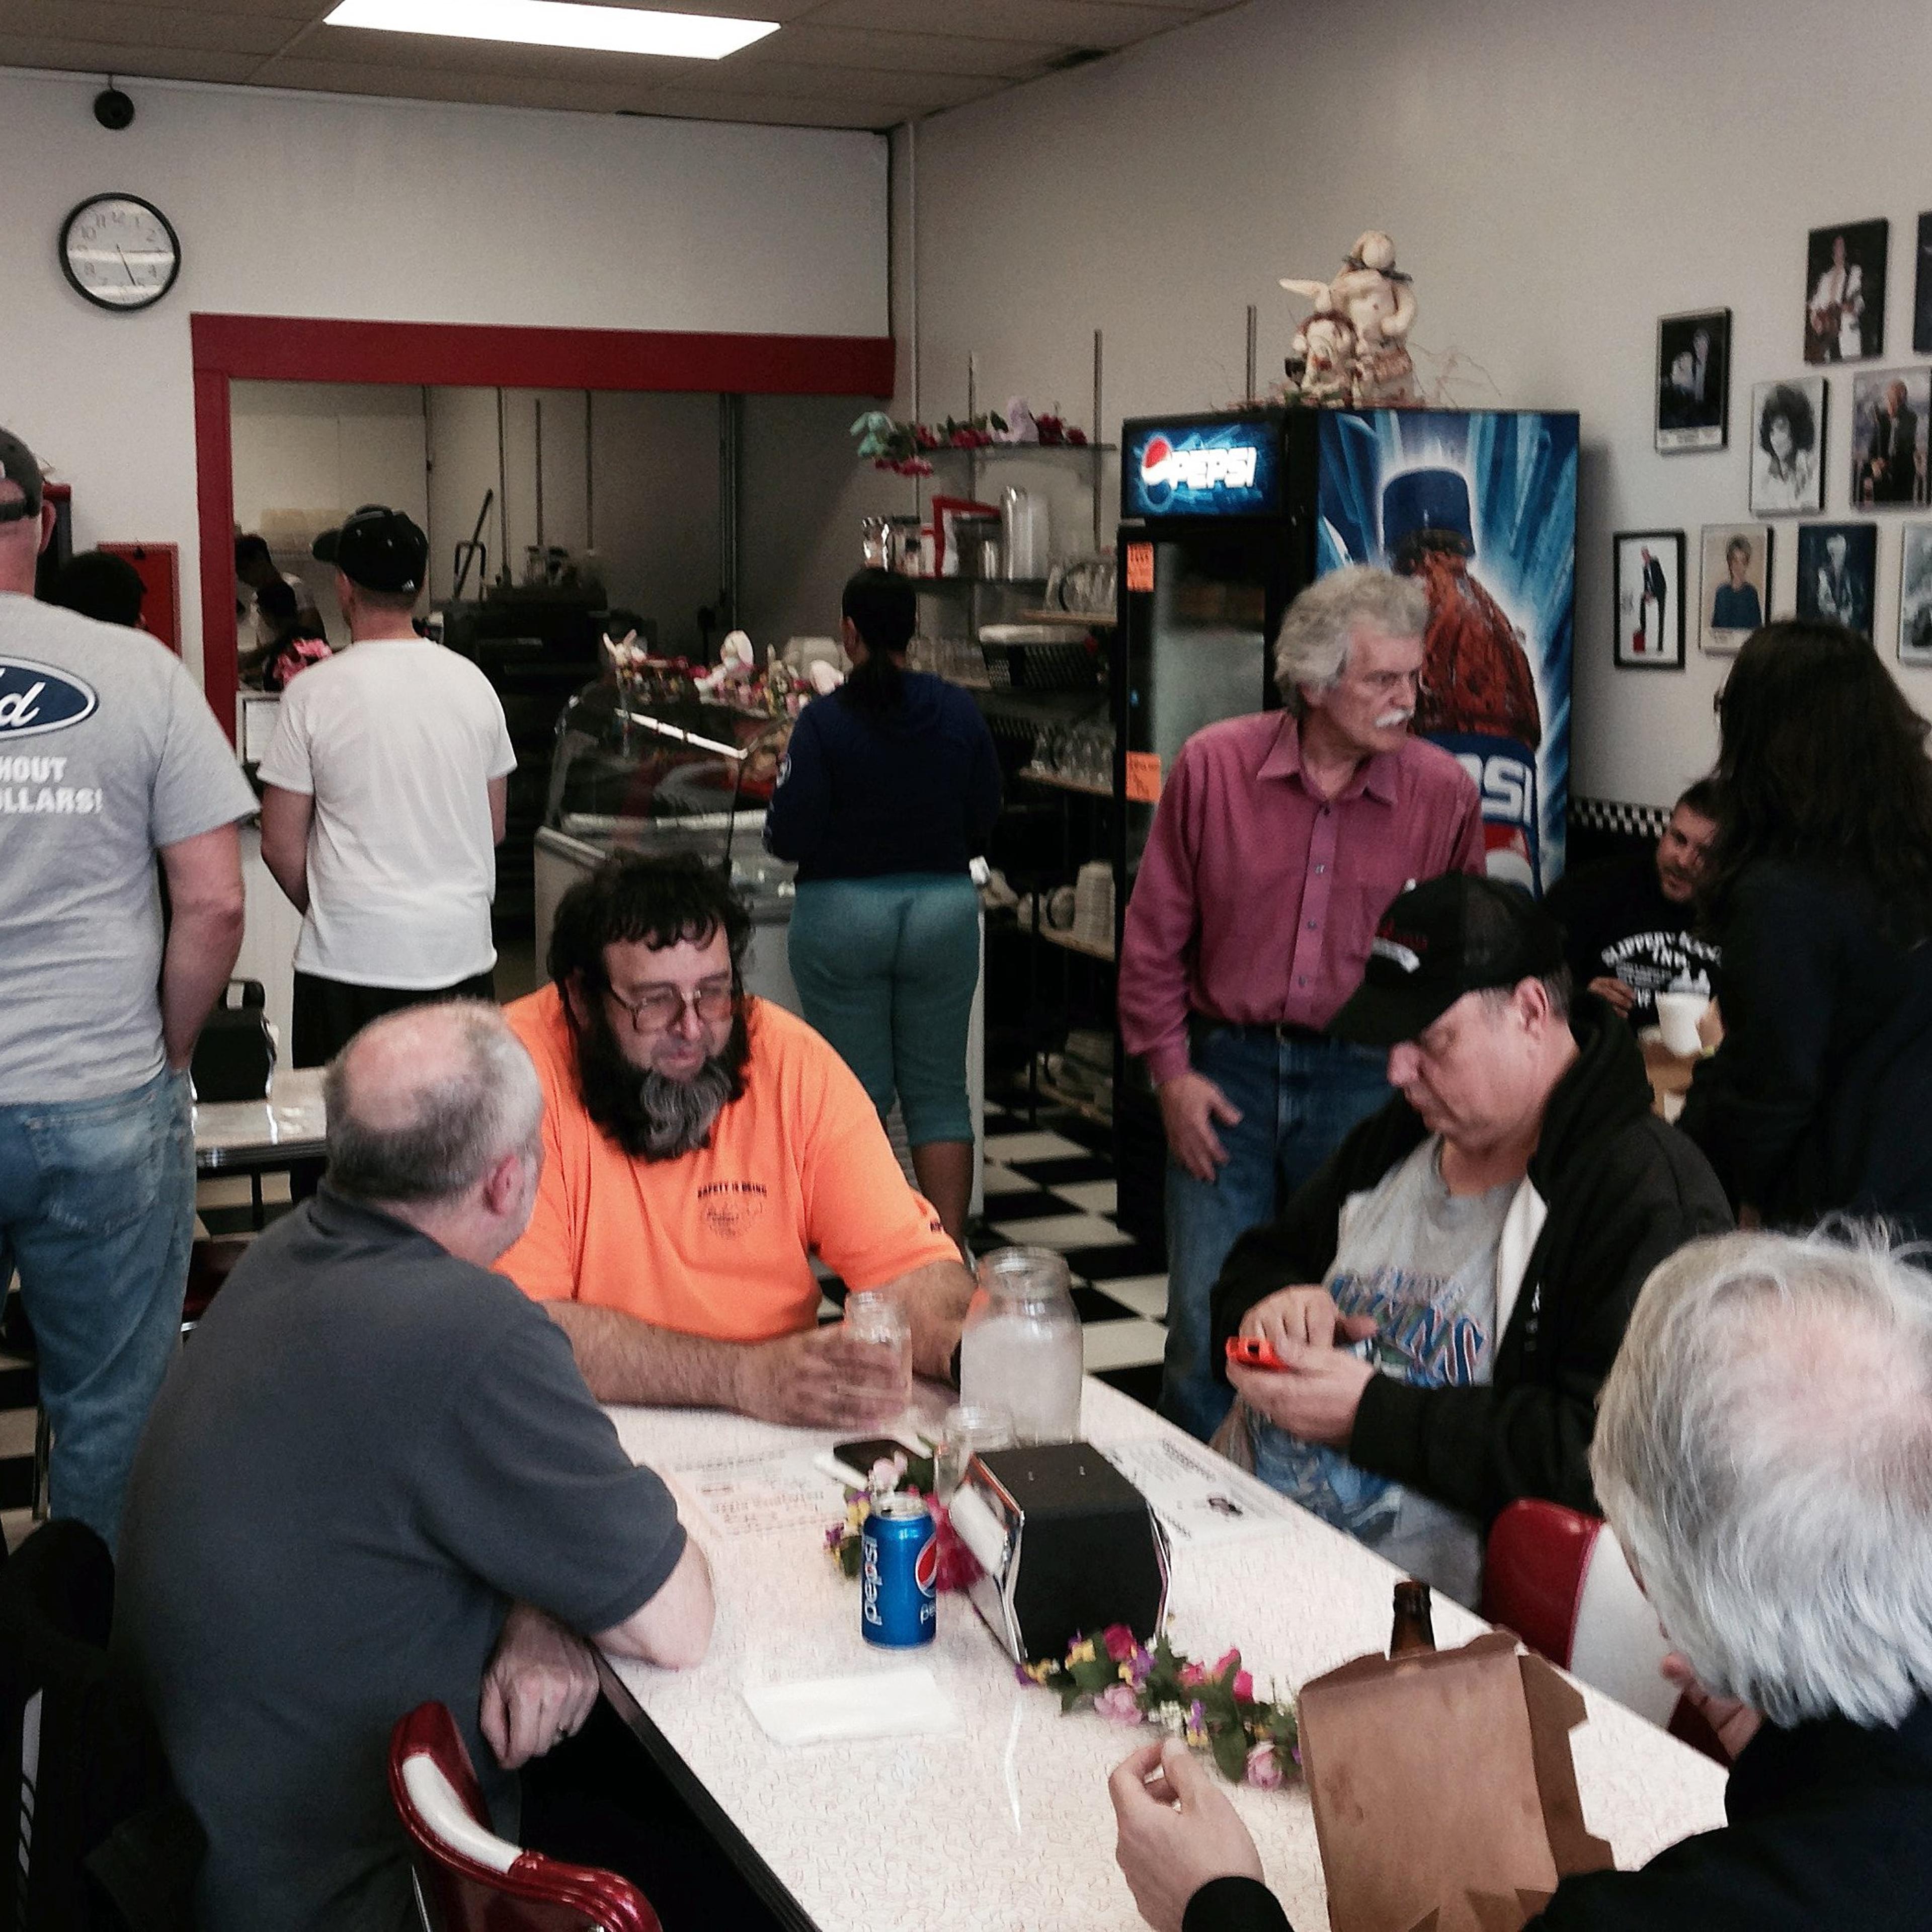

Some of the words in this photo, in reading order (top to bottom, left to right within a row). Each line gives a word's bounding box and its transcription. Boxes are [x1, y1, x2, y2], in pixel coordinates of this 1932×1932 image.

[1168, 447, 1257, 491] PEPSI
[0, 786, 103, 815] LLARS!
[863, 1536, 883, 1626] pepsi
